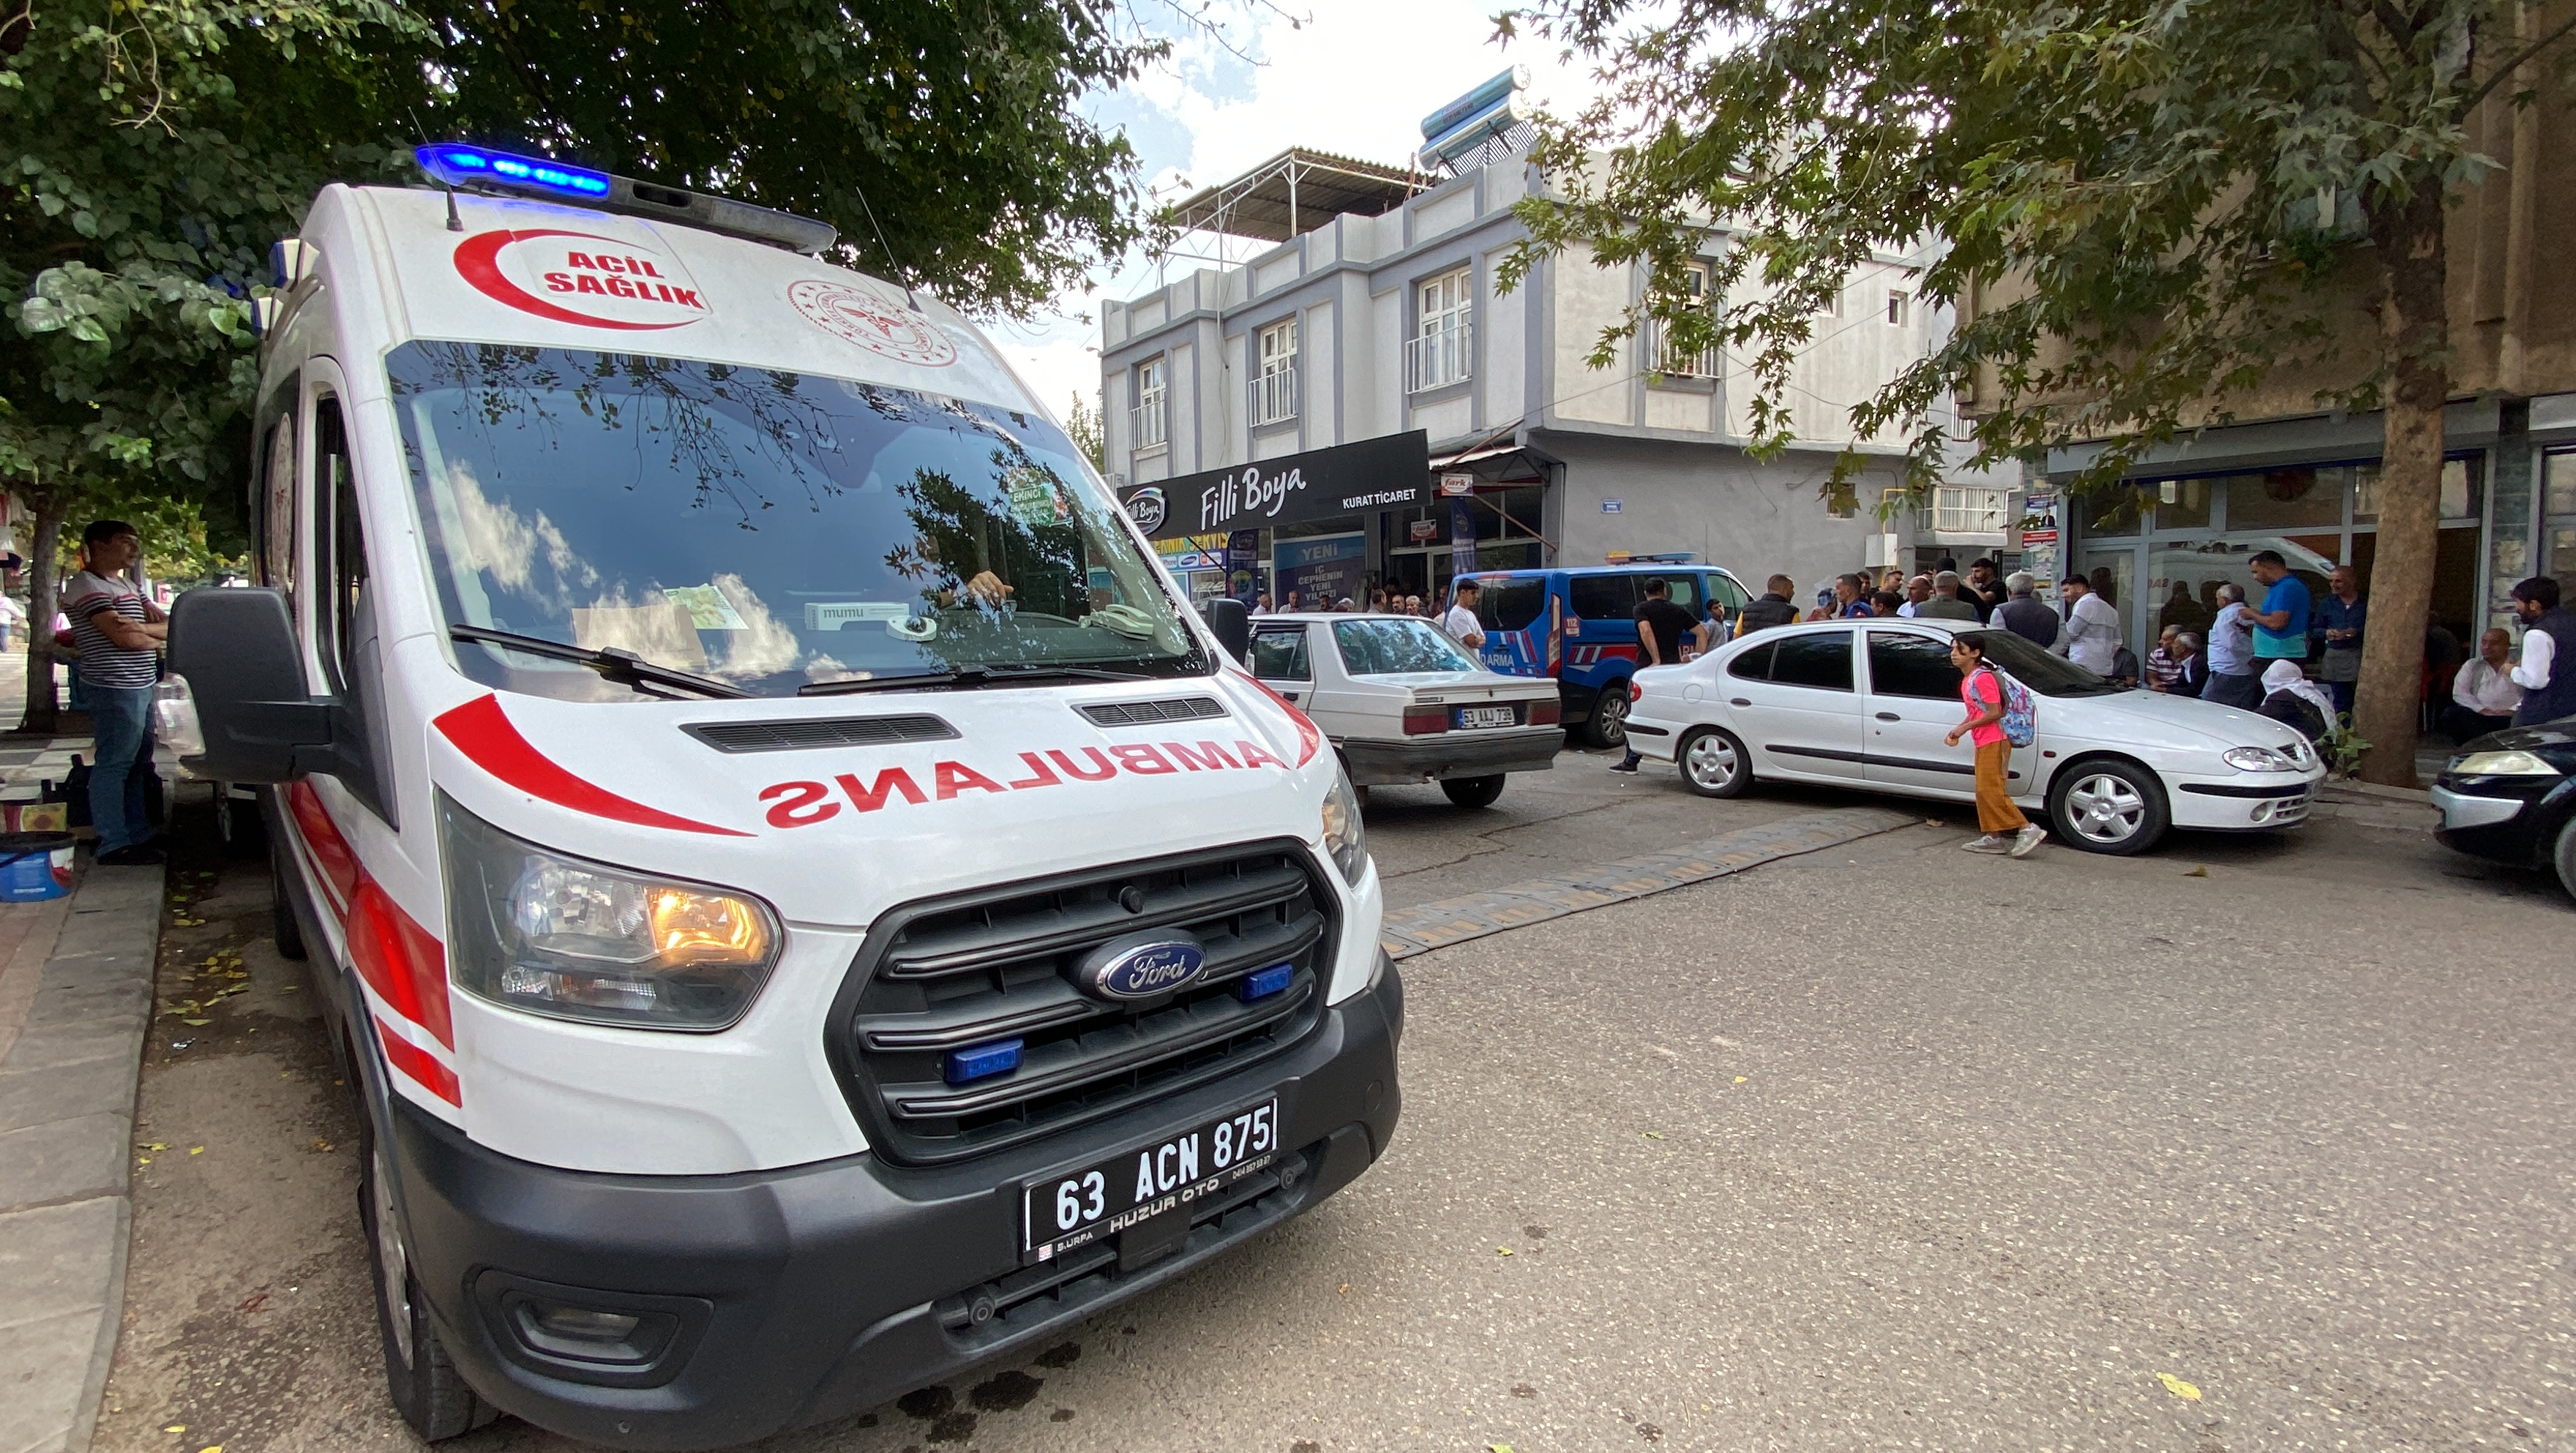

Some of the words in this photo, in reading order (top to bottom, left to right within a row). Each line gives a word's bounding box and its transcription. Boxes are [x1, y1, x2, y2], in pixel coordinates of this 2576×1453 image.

[544, 272, 705, 310] SAĞLIK
[1201, 474, 1238, 531] Filli
[1242, 467, 1307, 518] Boya
[1342, 494, 1374, 509] KURAT
[1374, 488, 1416, 505] TİCARET
[823, 609, 864, 618] mumu
[1566, 617, 1578, 628] 112
[1480, 653, 1515, 667] DARMA
[1129, 951, 1187, 988] Ford
[1057, 1171, 1105, 1231] 63
[1135, 1133, 1199, 1203] ACN
[1213, 1105, 1270, 1168] 875
[1110, 1195, 1176, 1234] HUZUR
[1181, 1178, 1219, 1203] OTO
